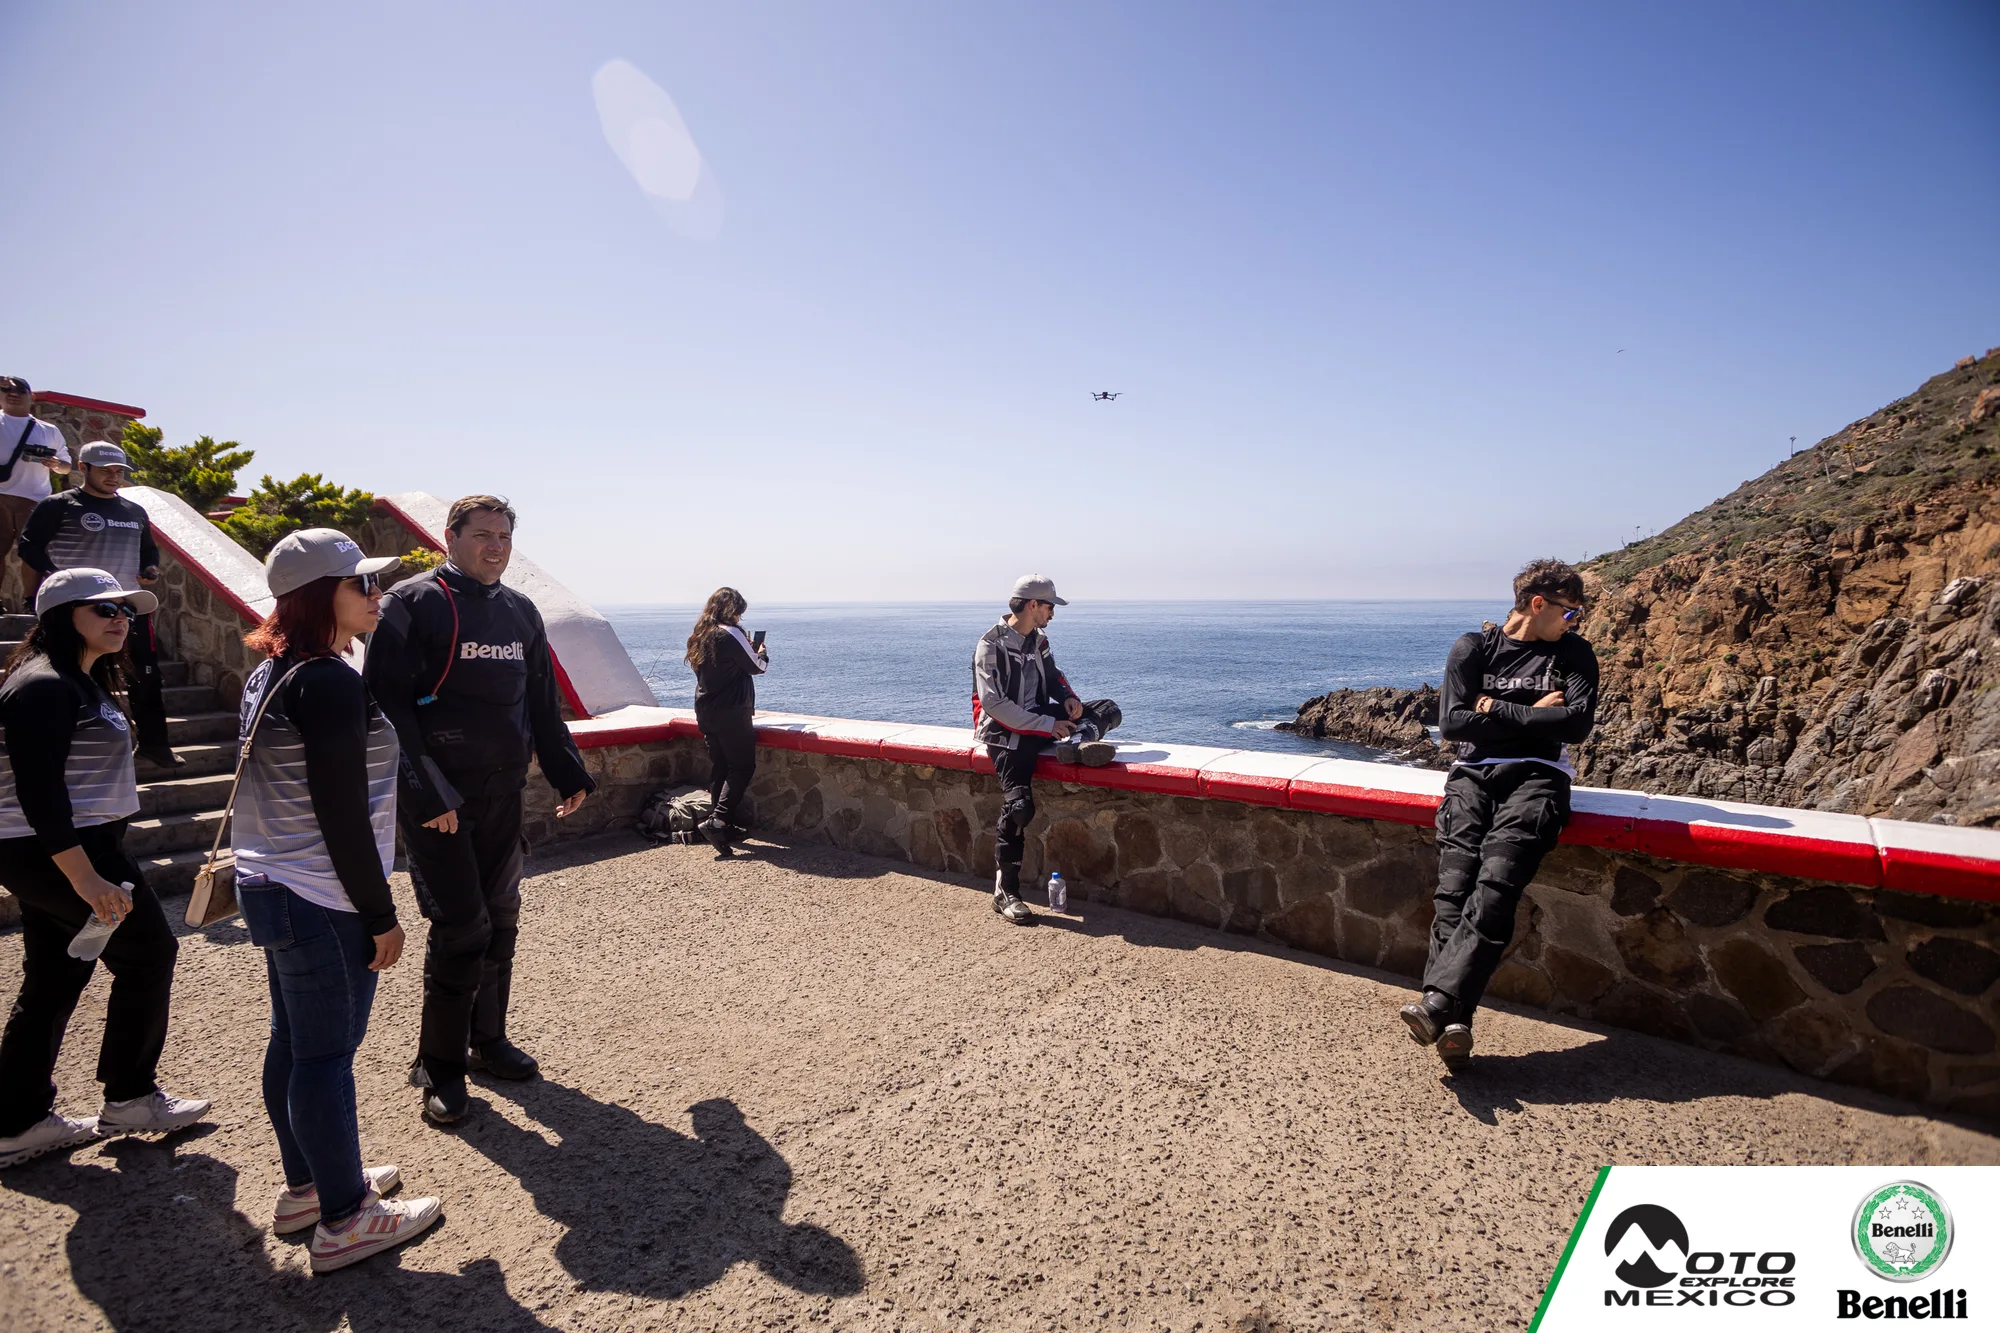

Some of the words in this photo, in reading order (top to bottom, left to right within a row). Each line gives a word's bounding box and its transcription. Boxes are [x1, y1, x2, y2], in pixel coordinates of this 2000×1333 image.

[107, 519, 139, 529] Benelli
[460, 641, 524, 660] Benelli
[1482, 673, 1556, 691] Benelli
